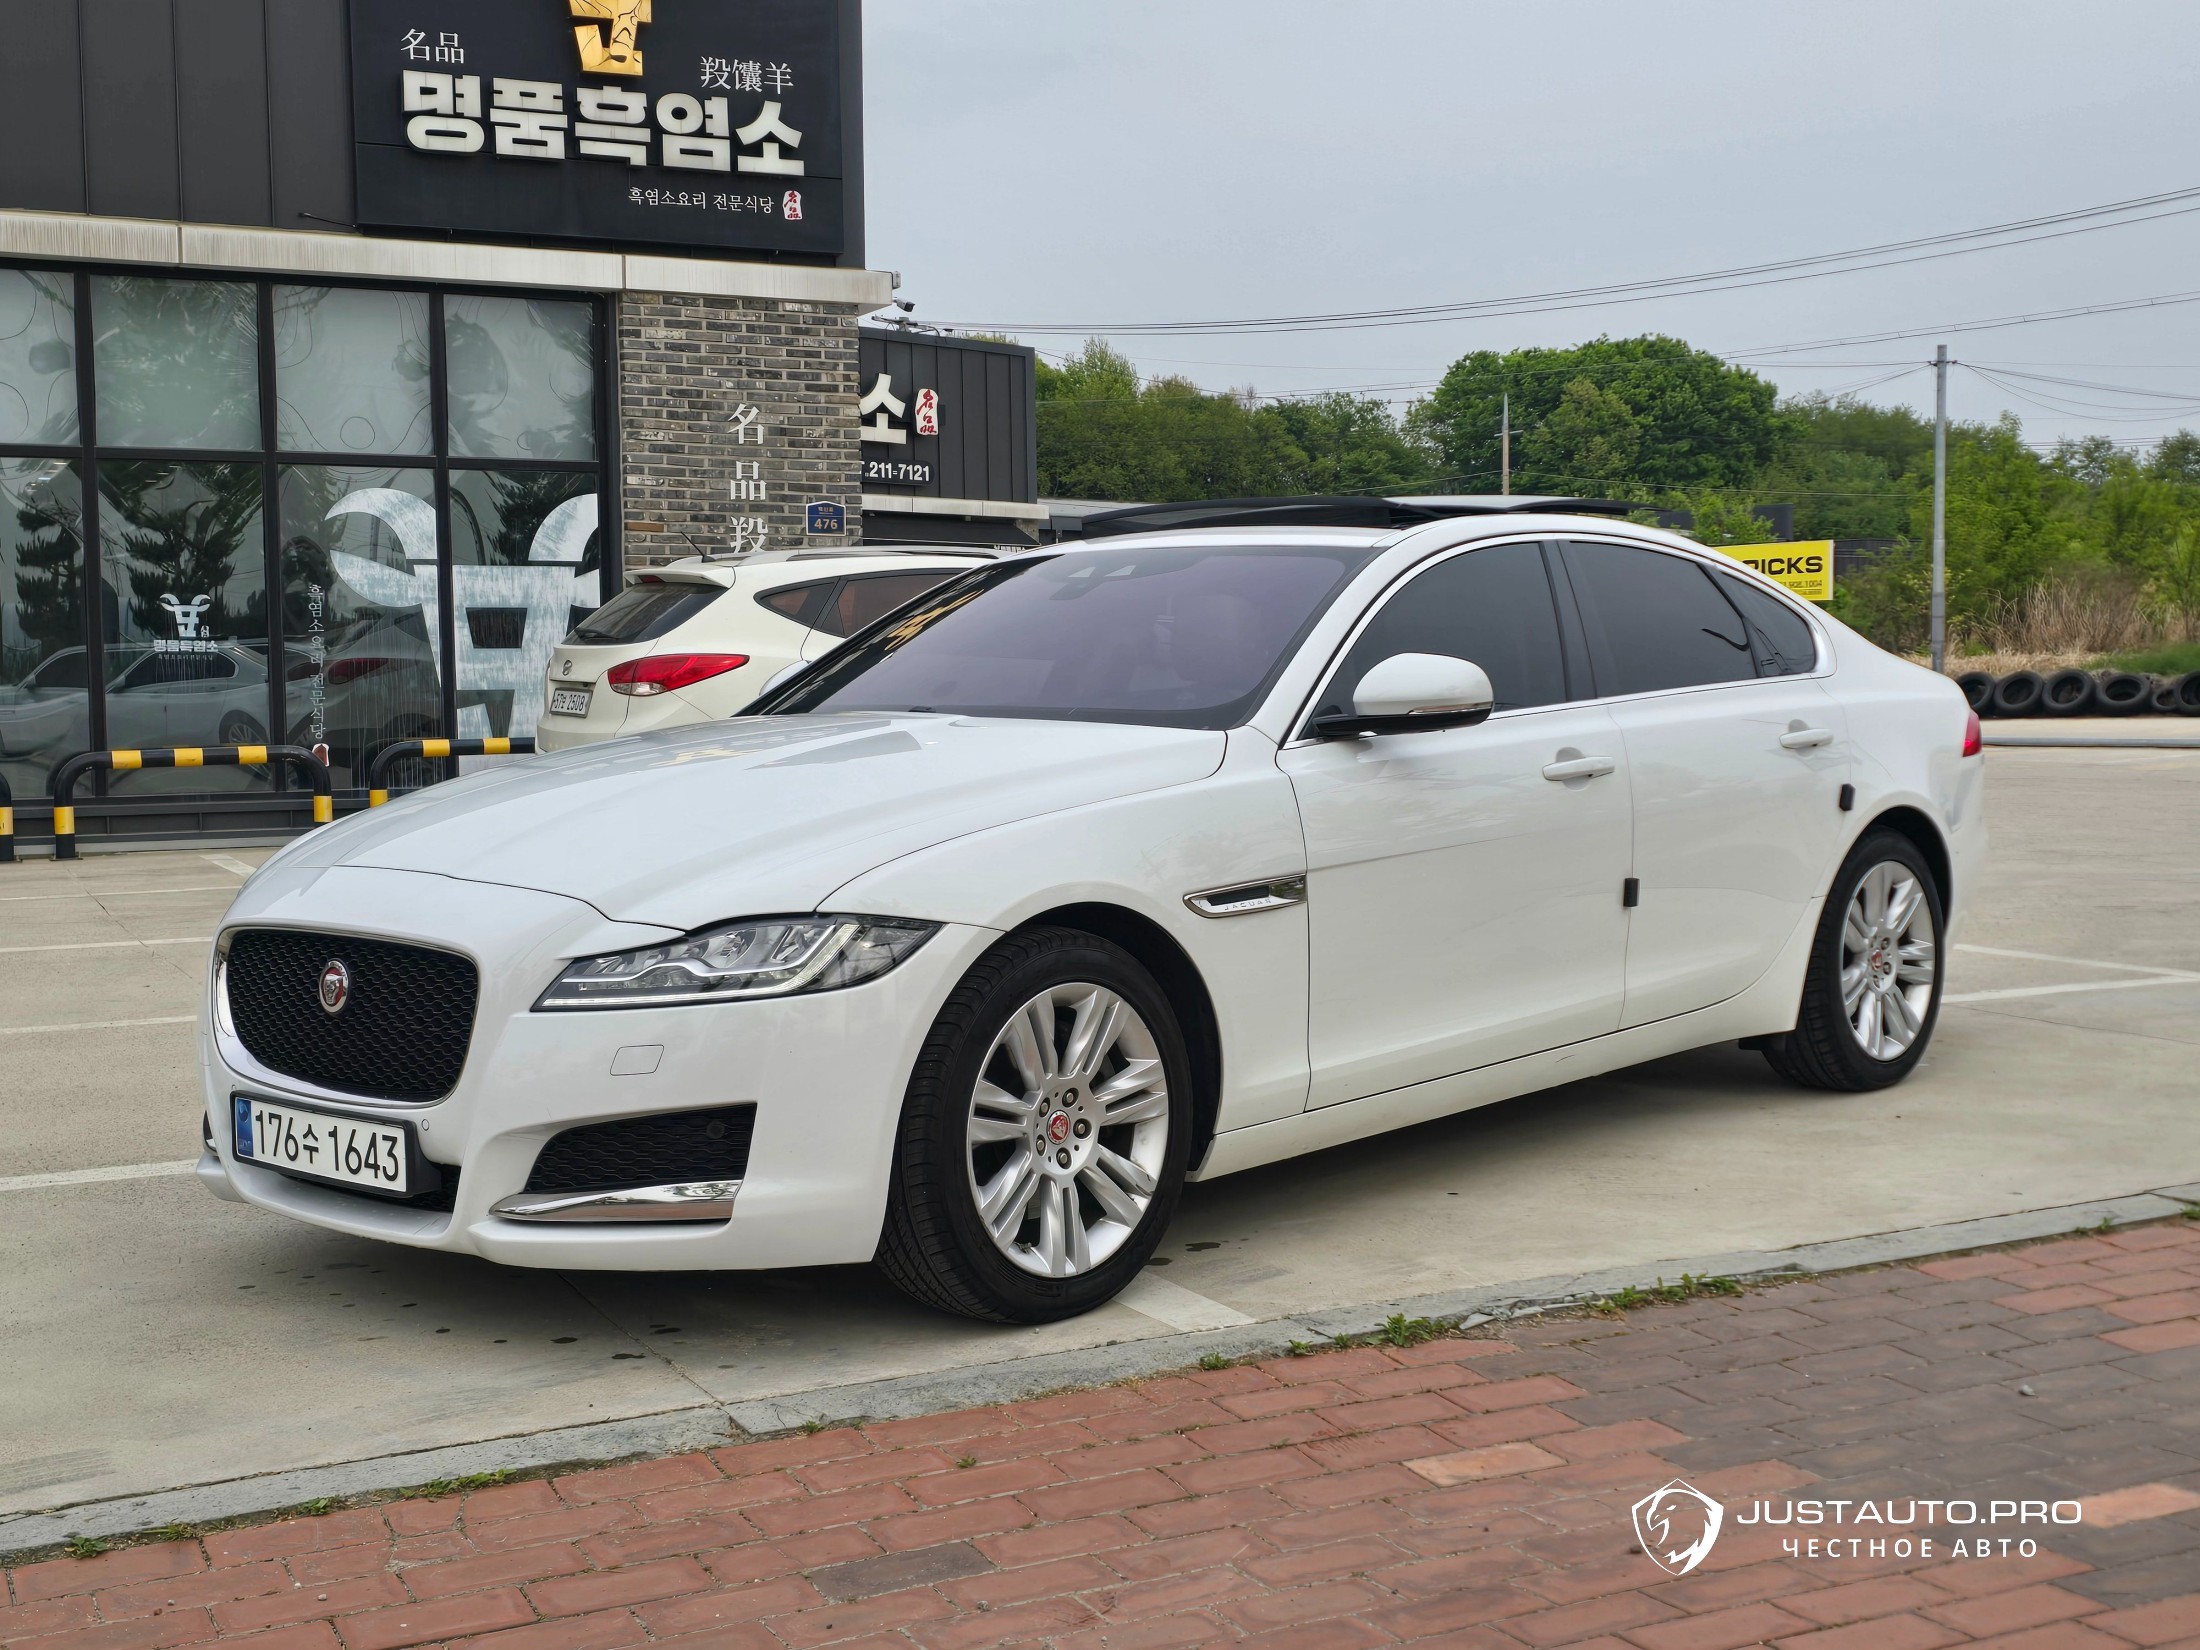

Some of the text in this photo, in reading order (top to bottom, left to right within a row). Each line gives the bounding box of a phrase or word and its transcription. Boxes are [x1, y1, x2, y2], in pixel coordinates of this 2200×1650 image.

[400, 28, 465, 64] 名品
[402, 69, 805, 177] 명품흑염소
[628, 186, 775, 214] 흑염소요리 전문식당
[814, 518, 838, 530] 476
[310, 672, 327, 740] 전문식당
[255, 1109, 399, 1183] 176수 1643
